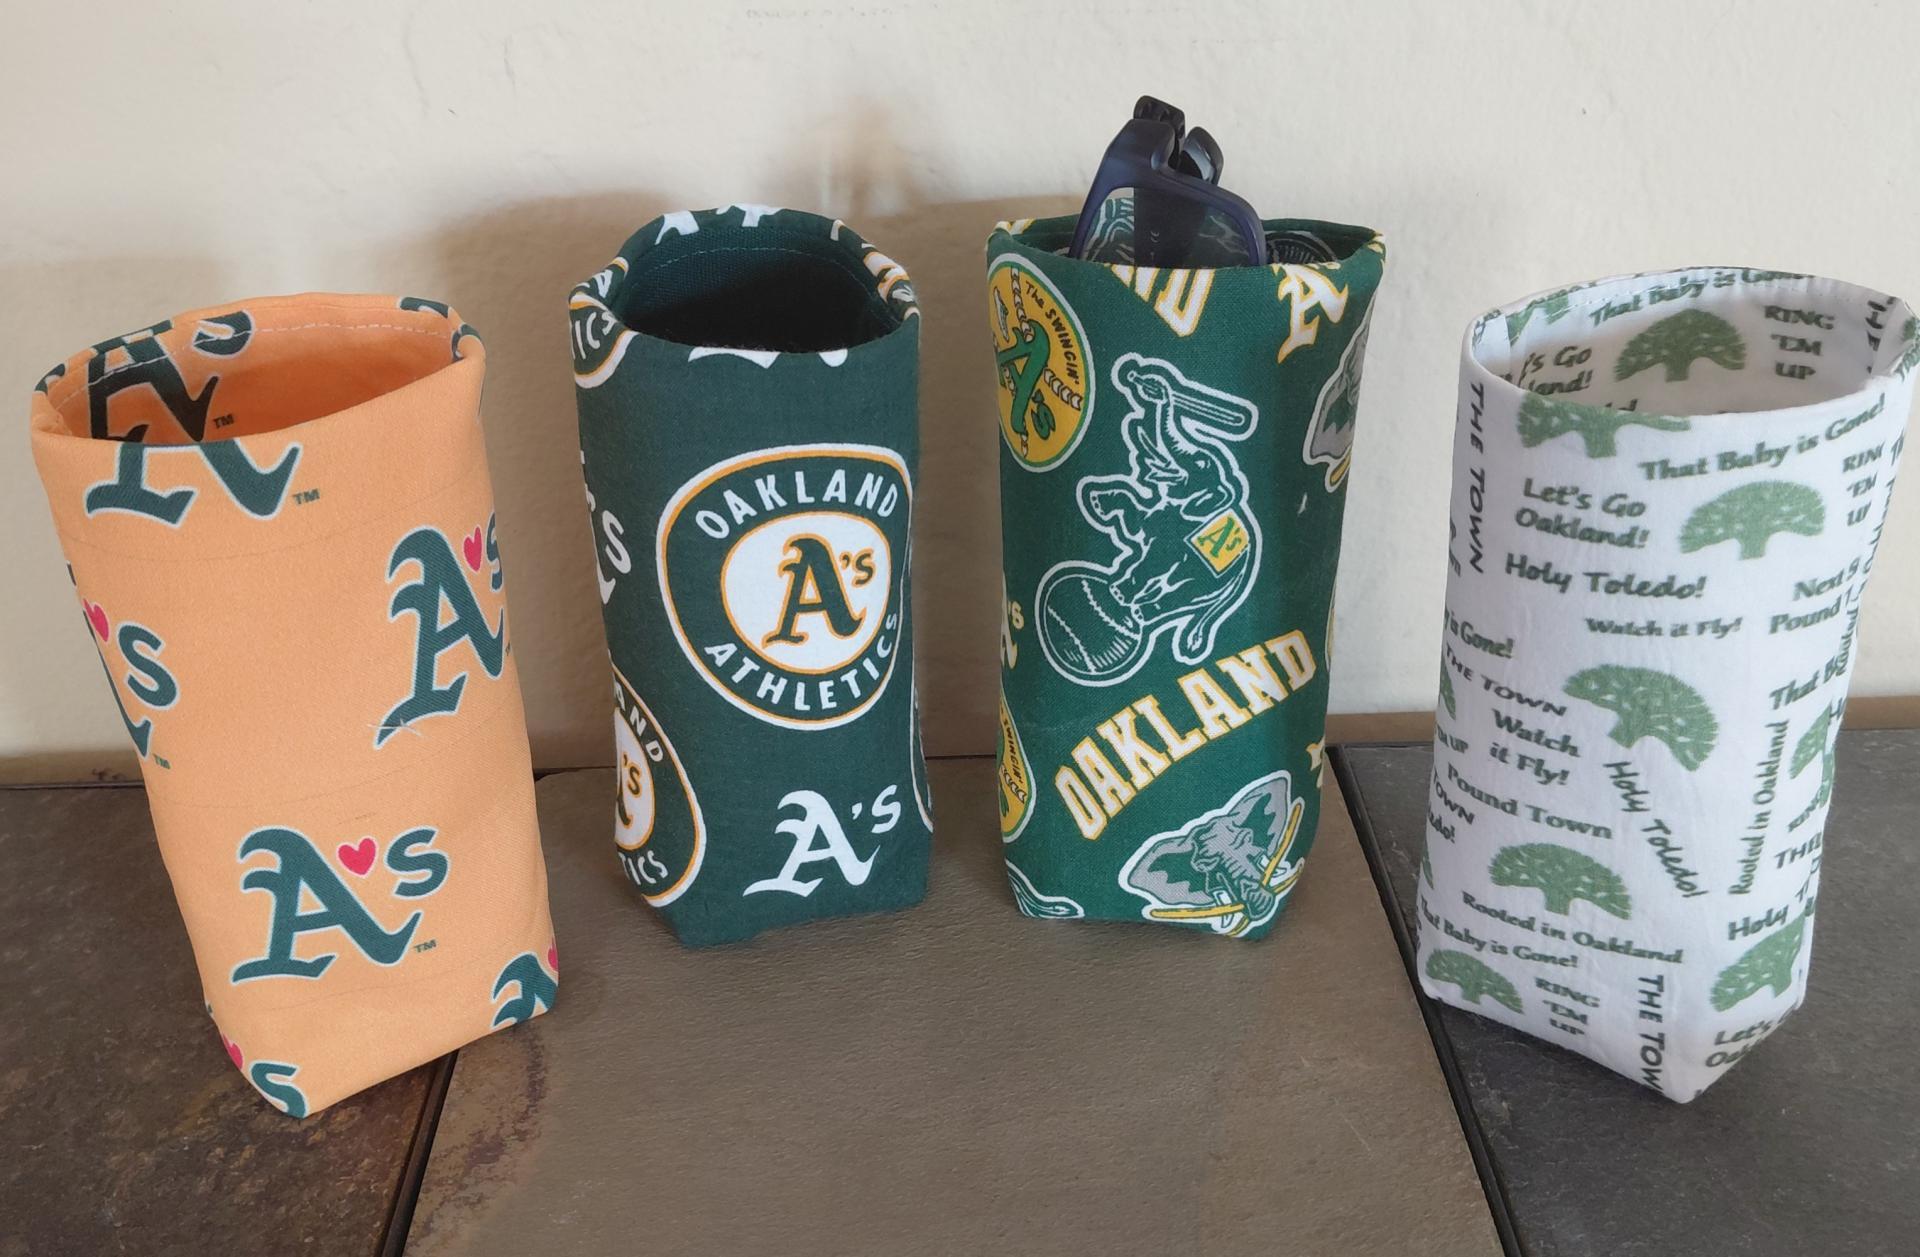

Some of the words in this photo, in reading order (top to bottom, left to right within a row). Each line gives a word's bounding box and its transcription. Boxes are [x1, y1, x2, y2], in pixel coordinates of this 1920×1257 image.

[1024, 280, 1045, 310] The
[1044, 308, 1080, 386] SWINGIN'
[1763, 305, 1836, 330] RING
[1553, 345, 1593, 368] Go
[1774, 360, 1817, 380] UP
[212, 412, 235, 428] TM
[1470, 382, 1484, 454] THE
[1639, 458, 1709, 482] That
[1717, 441, 1790, 471] Baby
[1797, 434, 1819, 454] is
[1825, 392, 1886, 441] Gone!
[292, 487, 321, 506] TM
[695, 468, 898, 540] OAKLAND
[1523, 478, 1592, 510] Let's
[1602, 493, 1646, 517] Go
[1469, 467, 1486, 574] TOWN
[1515, 506, 1650, 549] Oakland!
[761, 532, 876, 650] A's
[1505, 552, 1572, 593] Holy
[1583, 571, 1708, 599] Toledo!
[1793, 568, 1844, 601] Next
[1584, 617, 1662, 638] Watch
[1670, 623, 1689, 639] it
[1696, 617, 1743, 640] Fly!
[1768, 594, 1842, 635] Pound
[703, 613, 898, 711] ATHLETICS
[1461, 621, 1515, 660] Gone!
[1446, 642, 1474, 682] THE
[1479, 673, 1568, 718] TOWN
[1769, 679, 1820, 711] That
[1054, 628, 1318, 842] OAKLAND
[1491, 707, 1582, 758] Watch
[153, 753, 172, 771] TM
[1489, 742, 1511, 765] it
[1516, 752, 1570, 786] Fly!
[1752, 718, 1790, 806] Oakland
[1447, 762, 1519, 817] Pound
[1524, 803, 1614, 841] Town
[1747, 808, 1772, 831] in
[742, 783, 901, 898] A's
[1602, 761, 1651, 813] Holy
[1640, 818, 1710, 899] Toledo!
[1728, 834, 1766, 895] Rooted
[1420, 894, 1441, 931] That
[1443, 918, 1487, 952] Baby
[1490, 939, 1509, 955] is
[1512, 945, 1579, 968] Gone!
[1461, 890, 1536, 932] Rooted
[1541, 922, 1567, 941] in
[1572, 931, 1684, 964] Oakland
[1728, 905, 1789, 941] Holy
[414, 940, 437, 954] TM
[1535, 976, 1601, 1009] RING
[1637, 975, 1665, 1024] THE
[1549, 1018, 1586, 1036] UP
